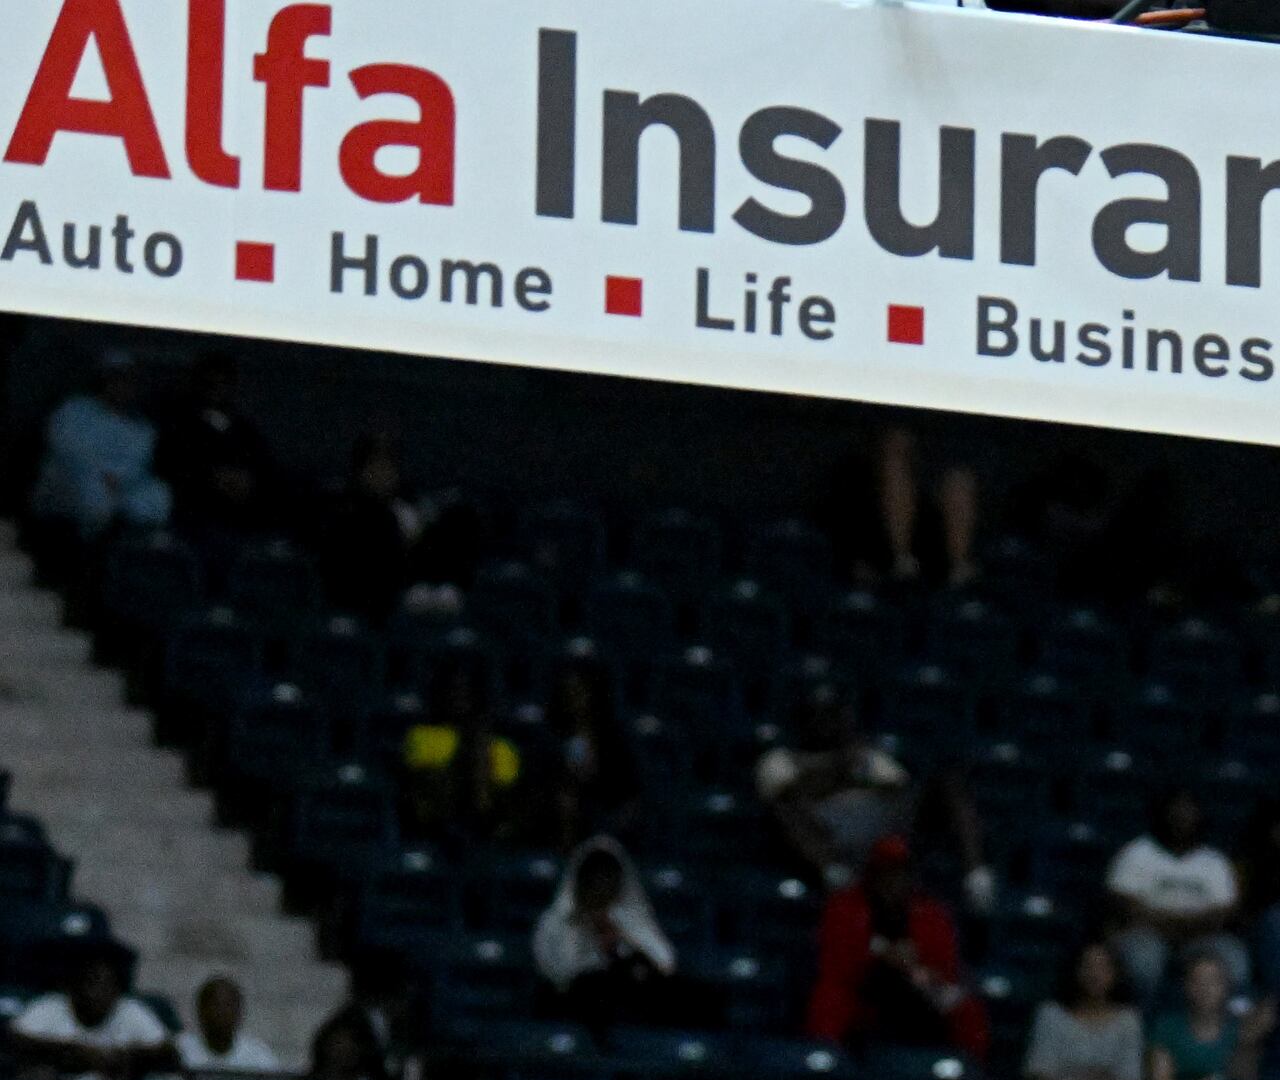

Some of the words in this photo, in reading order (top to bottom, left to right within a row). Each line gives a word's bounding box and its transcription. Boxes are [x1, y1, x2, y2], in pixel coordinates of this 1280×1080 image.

[3, 0, 457, 207] Alfa
[0, 200, 184, 279] Auto
[329, 230, 554, 313] Home
[695, 267, 837, 342] Life
